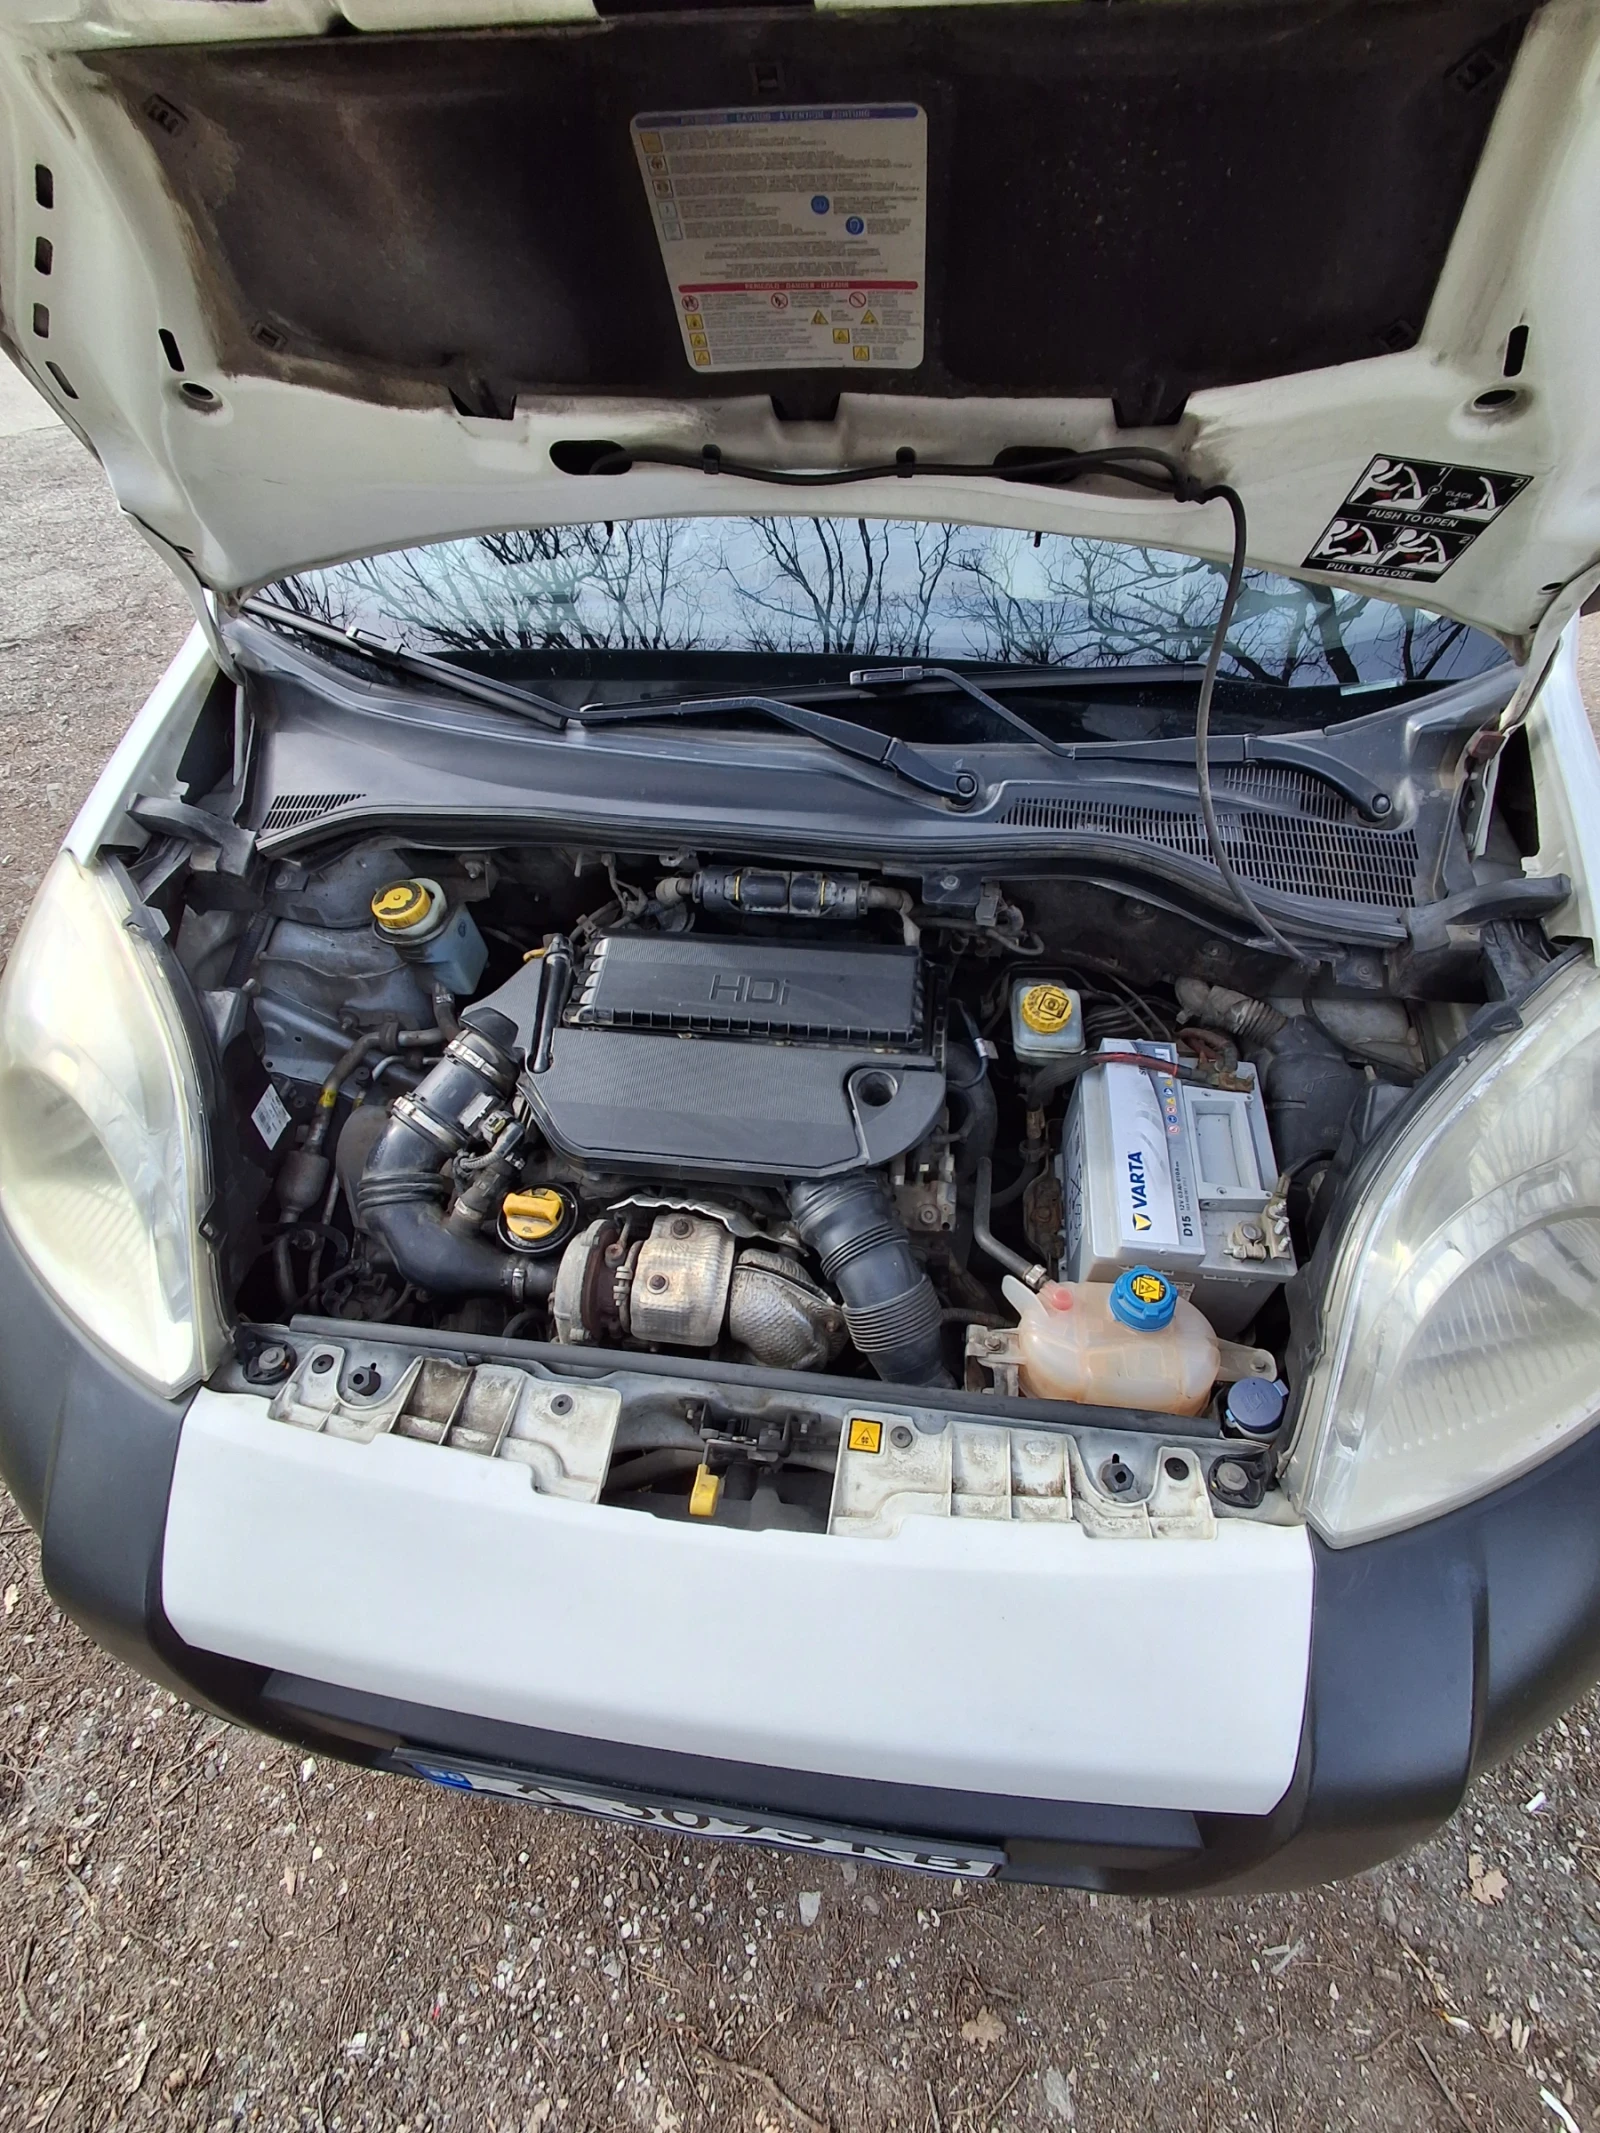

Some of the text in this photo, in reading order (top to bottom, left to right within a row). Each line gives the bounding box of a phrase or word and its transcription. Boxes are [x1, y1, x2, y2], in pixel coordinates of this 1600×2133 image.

[1439, 466, 1447, 477] 1
[1510, 478, 1524, 488] 2
[1445, 490, 1474, 500] CLACK
[1366, 508, 1459, 528] PUSH TO OPEN
[1392, 526, 1400, 535] 1
[1458, 535, 1470, 545] 2
[1326, 562, 1417, 579] PULL TO CLOSE
[1128, 1151, 1147, 1209] VARTA
[1181, 1215, 1194, 1237] D15
